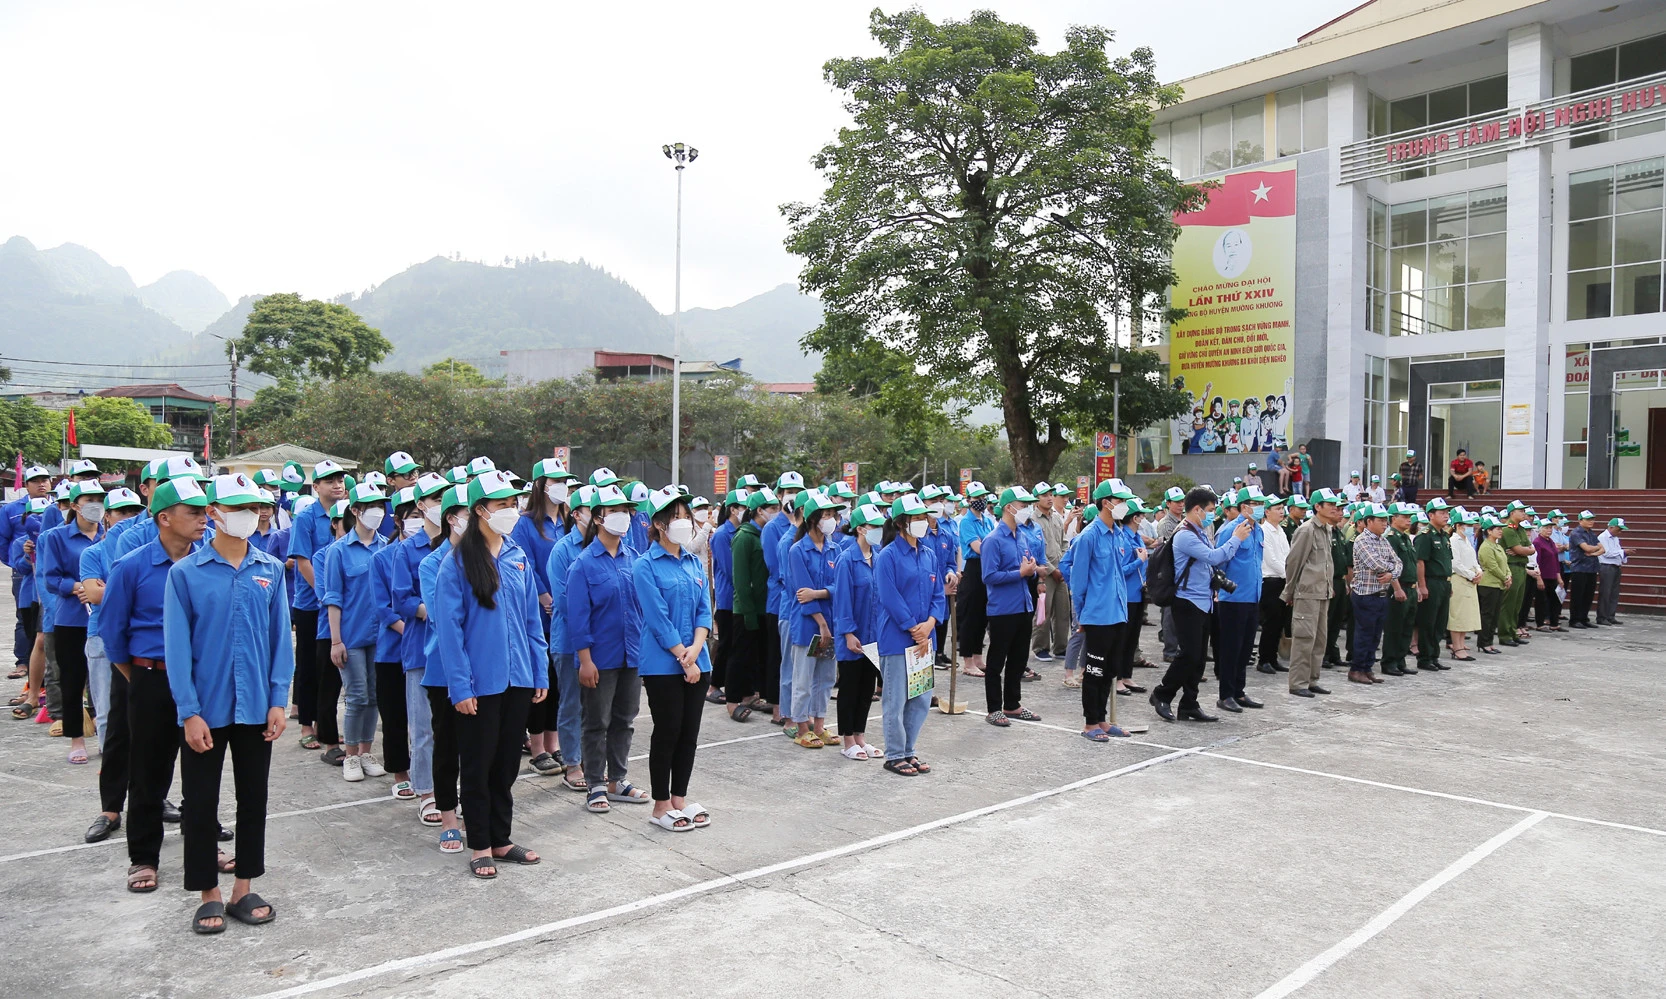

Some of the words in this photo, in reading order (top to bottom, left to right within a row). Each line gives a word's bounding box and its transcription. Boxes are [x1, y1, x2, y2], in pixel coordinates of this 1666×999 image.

[1385, 133, 1450, 163] TRUNG
[1454, 121, 1501, 149] TÂM
[1508, 109, 1546, 139] HỘI
[1554, 97, 1612, 128] NGHỊ
[1192, 284, 1214, 293] CHÀO
[1215, 281, 1239, 290] MỪNG
[1241, 279, 1255, 288] ĐẠI
[1258, 276, 1271, 285] HỘI
[1189, 294, 1213, 307] LẦN
[1216, 290, 1242, 303] THỨ
[1244, 288, 1275, 300] XXIV
[1199, 307, 1208, 318] BỘ
[1209, 306, 1230, 316] HUYỆN
[1230, 303, 1255, 313] MƯỜNG
[1256, 301, 1283, 310] KHƯƠNG
[1224, 324, 1241, 334] TRONG
[1241, 322, 1256, 332] SẠCH
